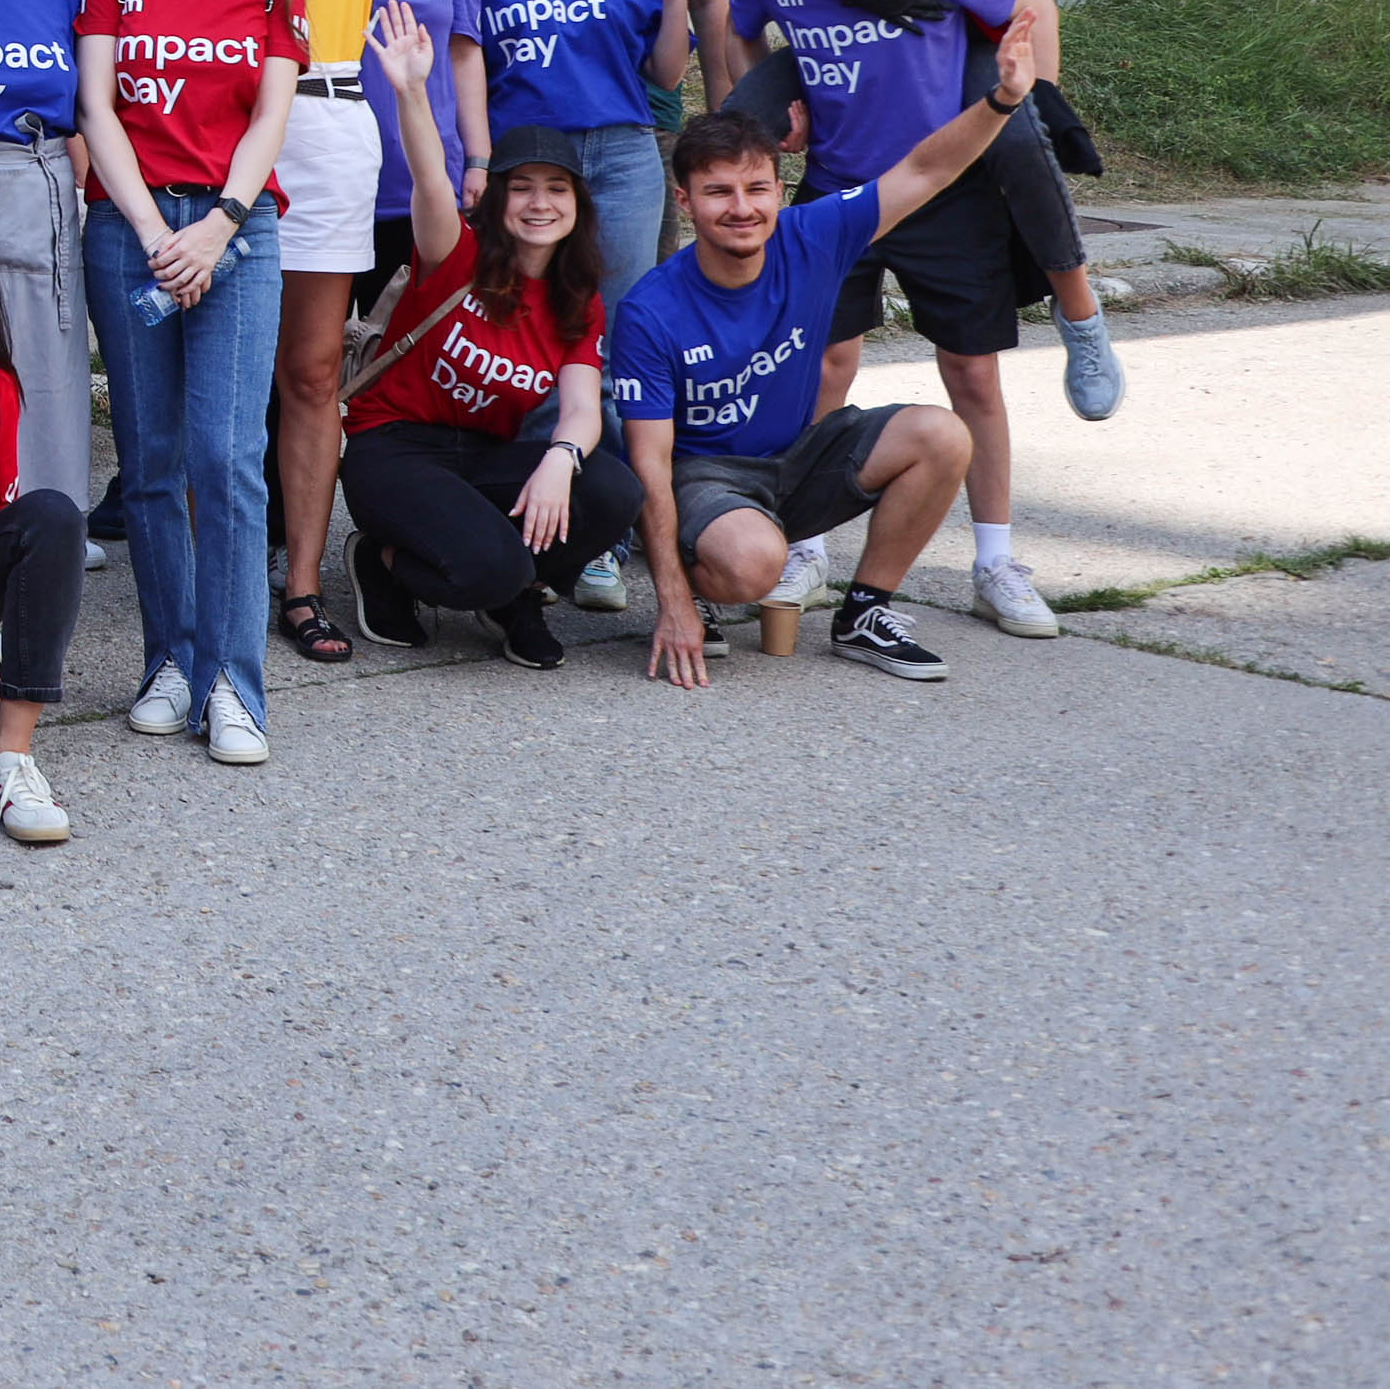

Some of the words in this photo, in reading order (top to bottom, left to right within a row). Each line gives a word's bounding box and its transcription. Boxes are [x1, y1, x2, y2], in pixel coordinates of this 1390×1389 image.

[497, 33, 559, 69] Day
[784, 16, 905, 57] Impac
[116, 72, 187, 115] Day
[796, 56, 862, 95] Day
[441, 321, 555, 396] Impac
[682, 344, 715, 366] um
[685, 325, 807, 402] Impact
[430, 357, 500, 413] Day
[686, 394, 760, 427] Day
